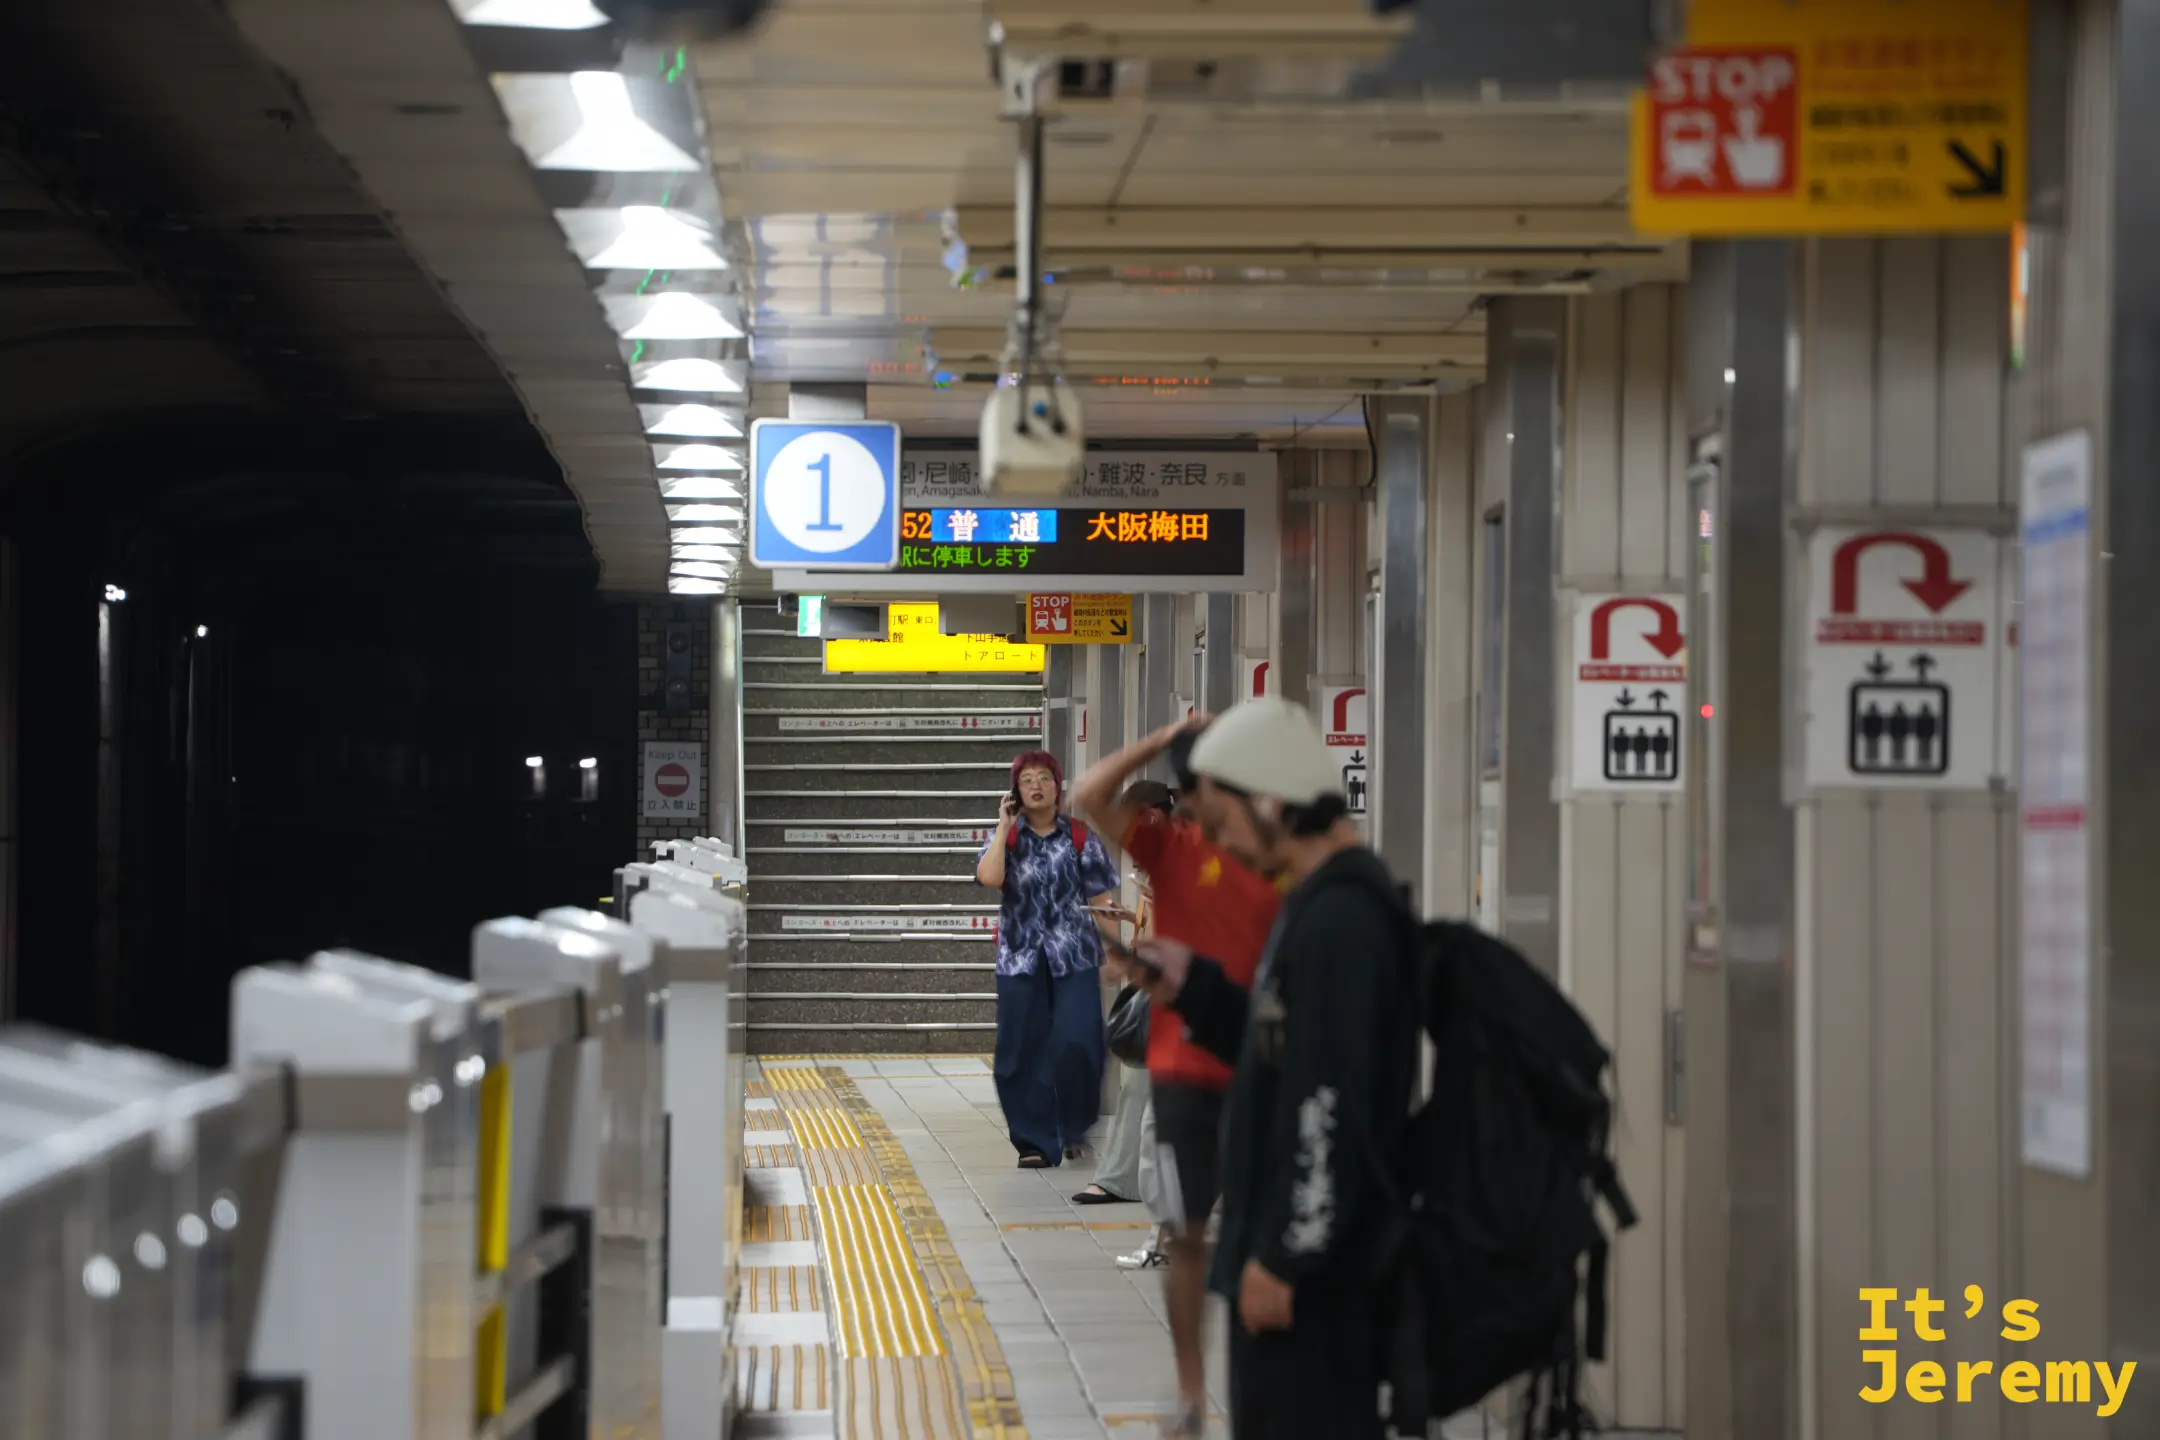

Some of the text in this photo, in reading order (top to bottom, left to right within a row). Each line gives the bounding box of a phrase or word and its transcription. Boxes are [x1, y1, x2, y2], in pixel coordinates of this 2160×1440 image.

[1653, 56, 1794, 104] STOP
[1216, 472, 1246, 487] 方面
[806, 453, 843, 531] 1
[1130, 485, 1159, 497] Nara
[902, 512, 932, 539] 52
[1086, 511, 1209, 542] 大阪梅田
[1032, 596, 1070, 608] STOP
[964, 650, 1037, 661] トアロード
[647, 800, 697, 811] 立入禁止
